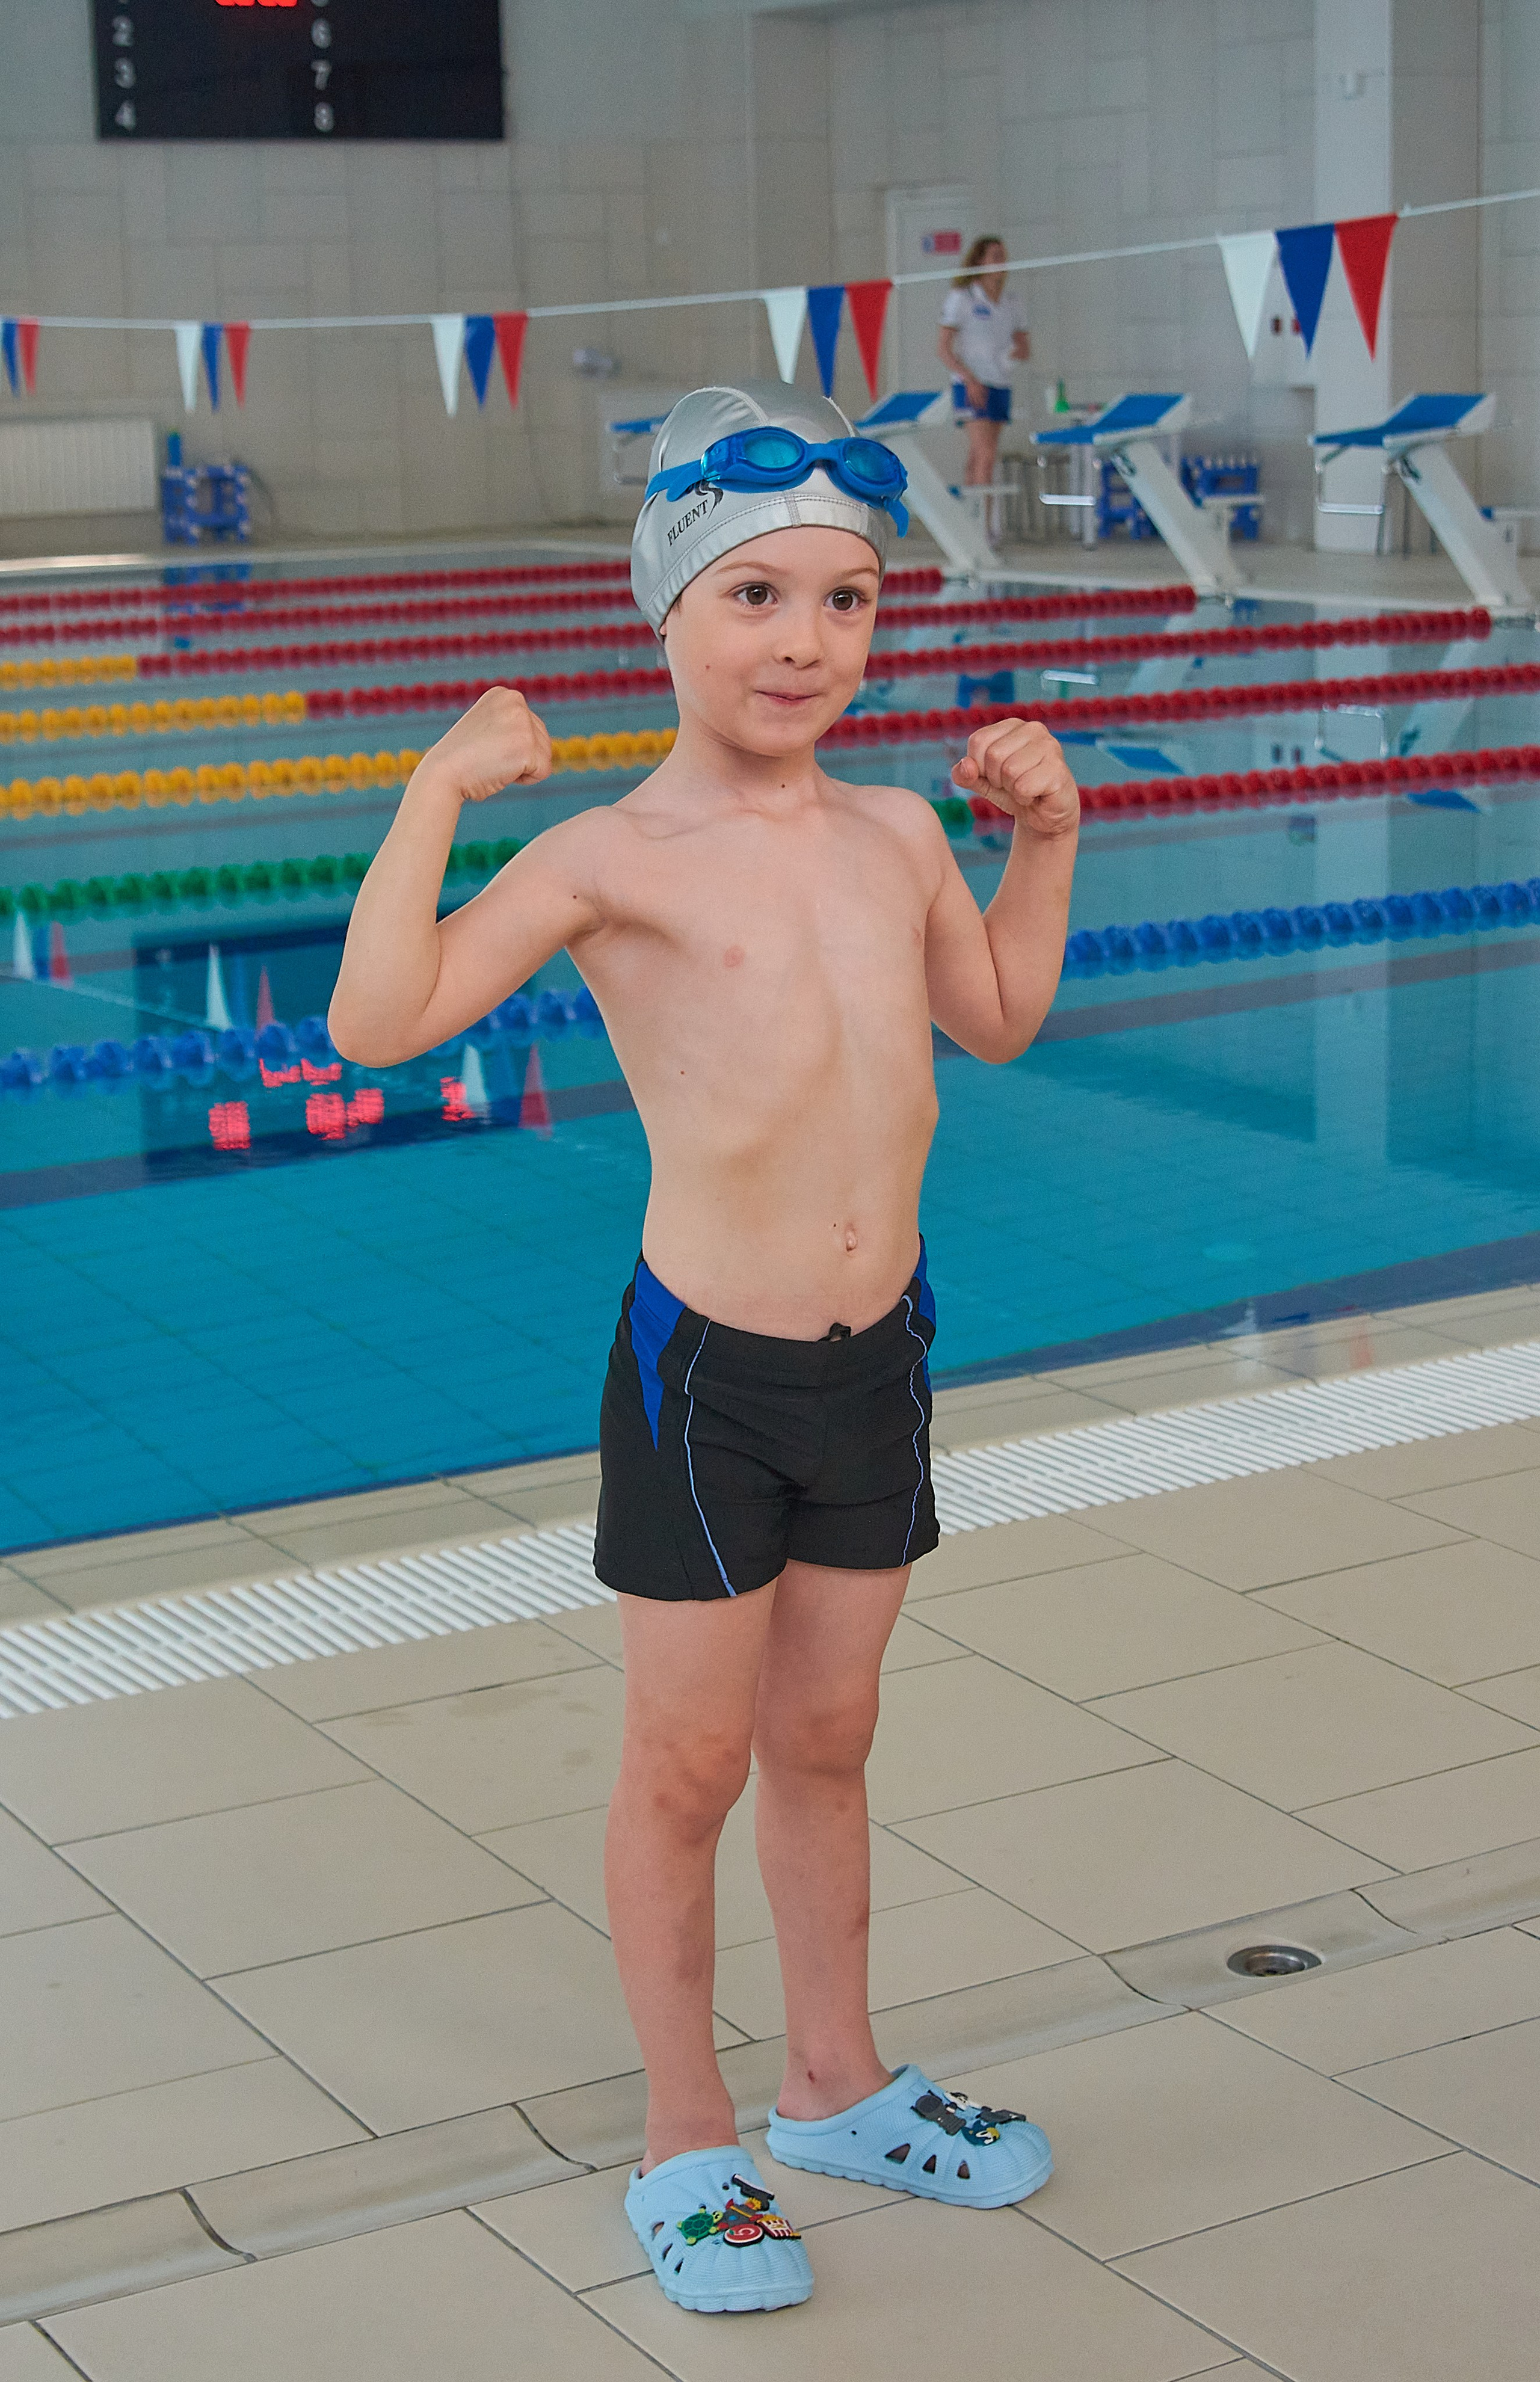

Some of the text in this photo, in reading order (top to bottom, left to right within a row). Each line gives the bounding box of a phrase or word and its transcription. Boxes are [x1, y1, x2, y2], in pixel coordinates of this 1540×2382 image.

[112, 16, 133, 47] 2
[311, 18, 332, 48] 6
[115, 57, 136, 89] 3
[312, 60, 332, 90] 7
[115, 100, 137, 131] 4
[314, 102, 334, 132] 8
[667, 499, 708, 547] FLUENT
